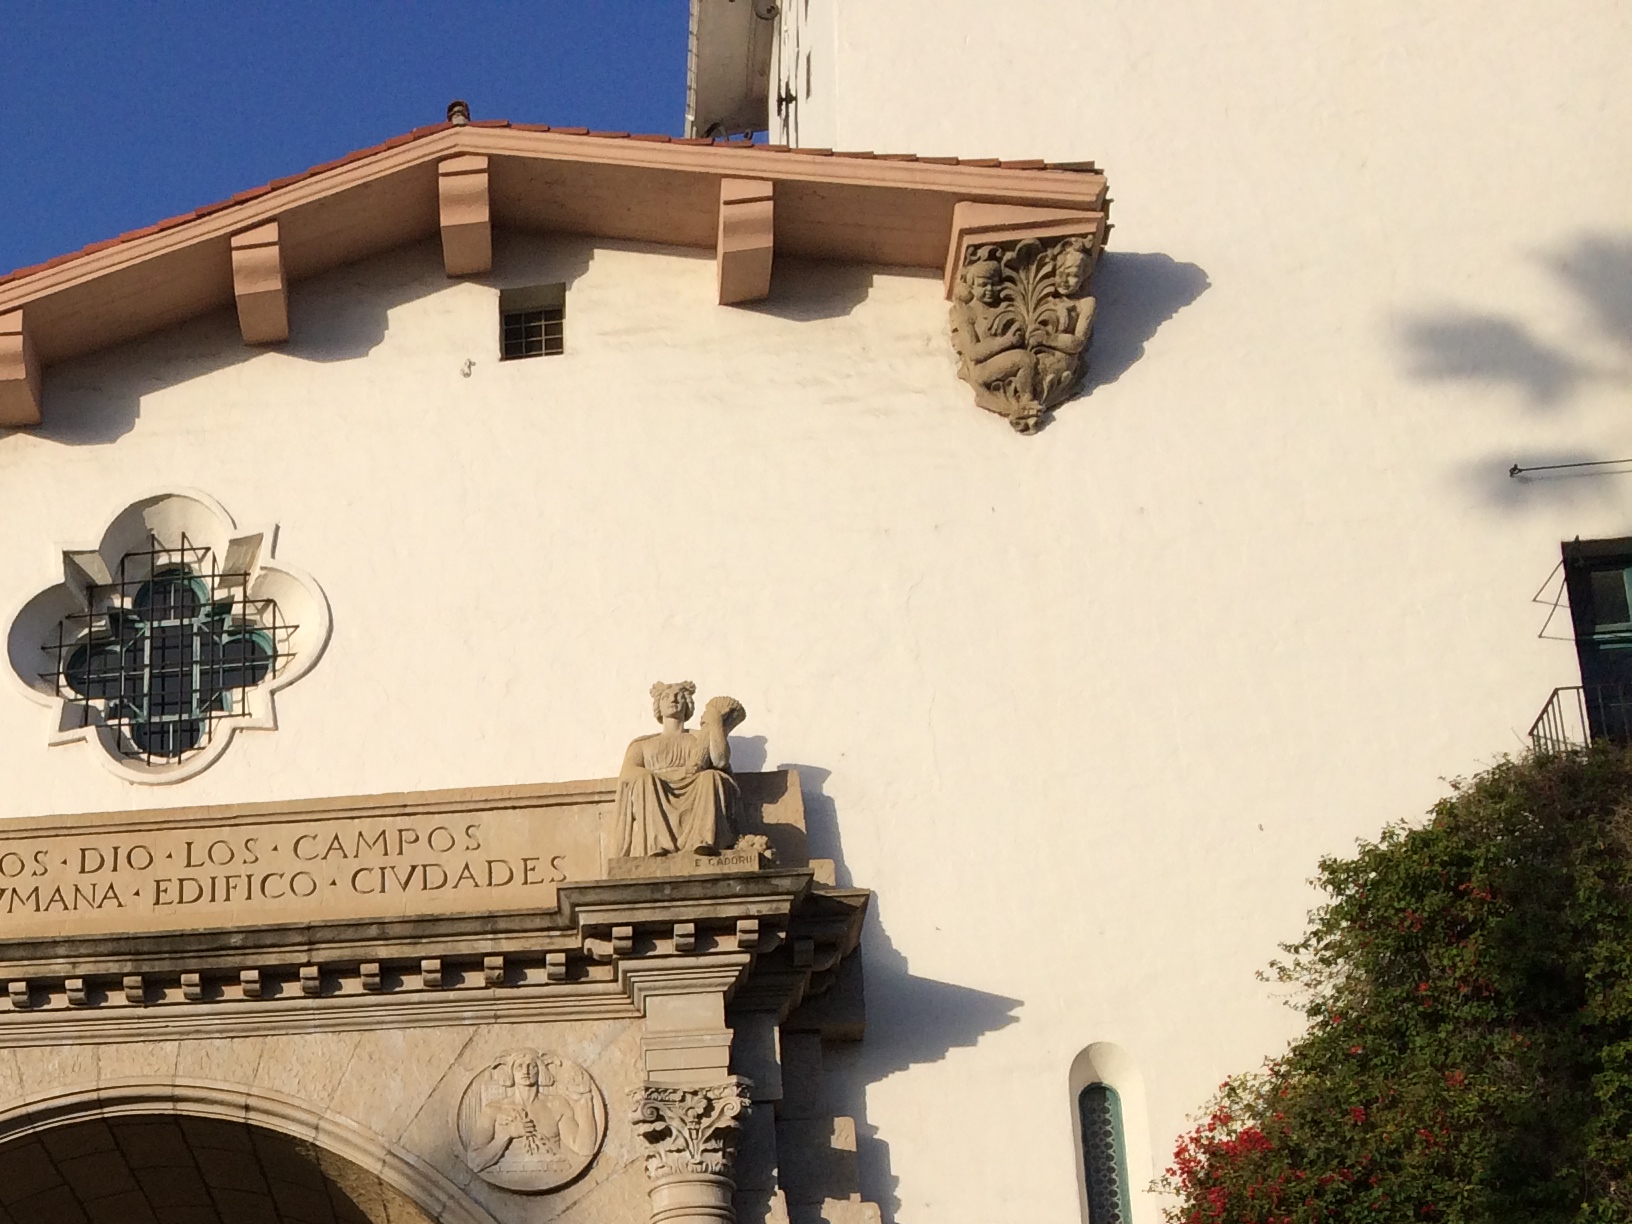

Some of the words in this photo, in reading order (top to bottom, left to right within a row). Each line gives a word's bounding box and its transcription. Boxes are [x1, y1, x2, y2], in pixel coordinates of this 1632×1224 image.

[78, 844, 155, 875] DIO
[183, 837, 261, 868] LOS
[292, 823, 483, 861] CAMPOS
[152, 870, 318, 906] EDIFICO
[350, 855, 568, 894] CIVDADES
